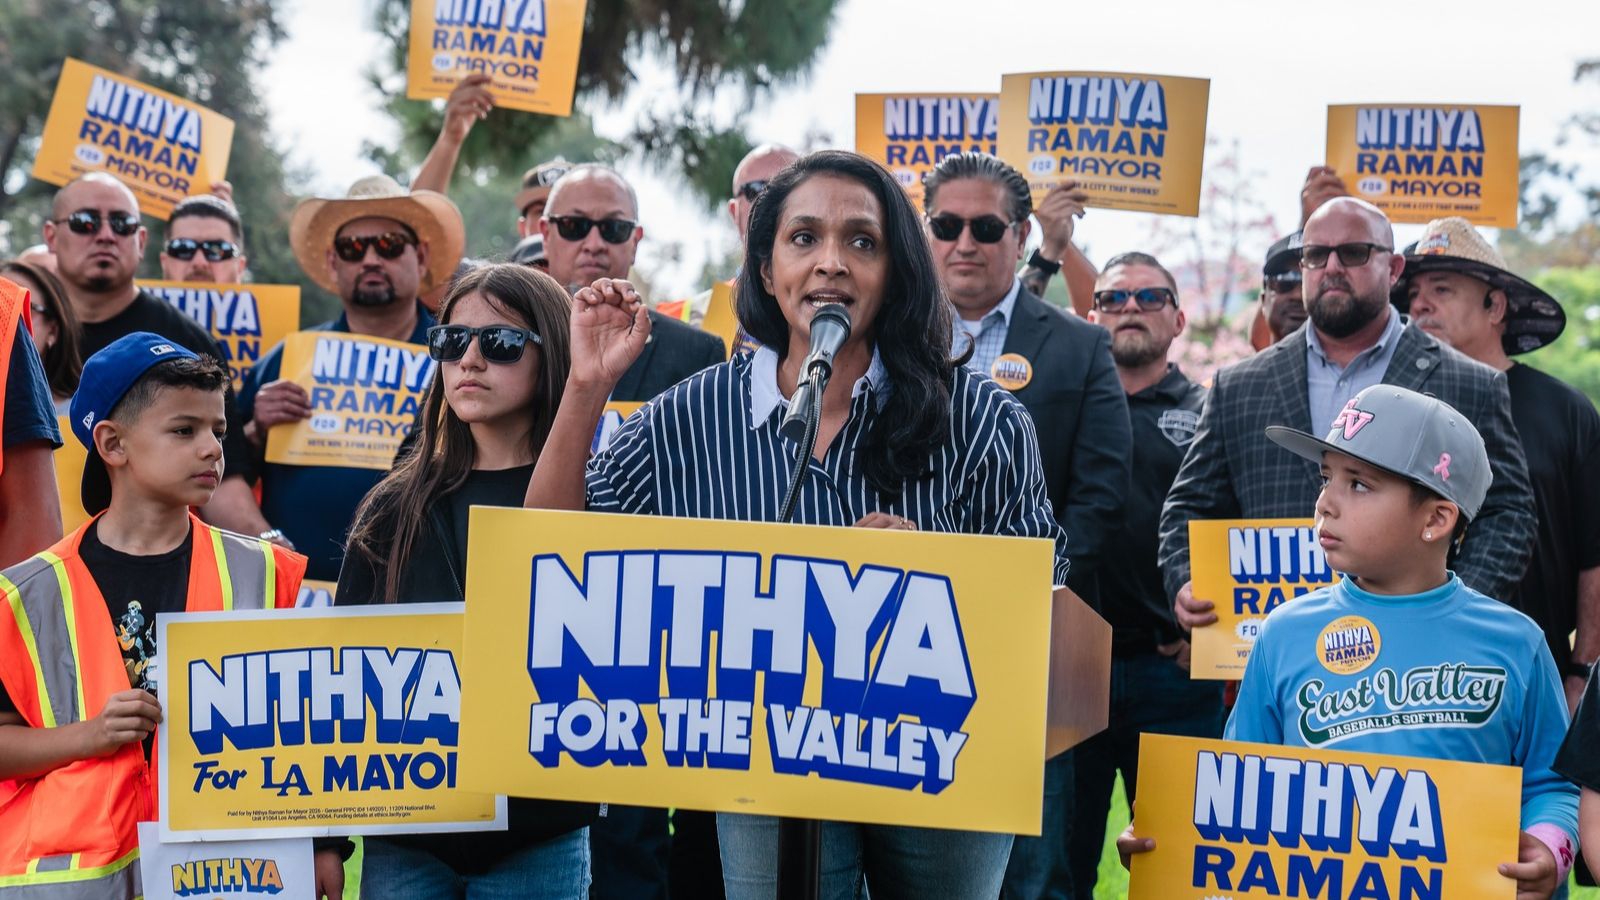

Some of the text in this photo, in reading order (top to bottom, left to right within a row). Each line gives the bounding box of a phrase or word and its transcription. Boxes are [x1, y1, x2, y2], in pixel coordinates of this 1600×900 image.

[432, 29, 543, 61] RAMAN
[455, 56, 539, 80] MAYOR
[86, 75, 201, 153] NITHYA
[1028, 77, 1168, 131] NITHYA
[79, 119, 198, 176] RAMAN
[1028, 128, 1165, 158] RAMAN
[1356, 109, 1485, 153] NITHYA
[106, 154, 190, 195] MAYOR
[1059, 156, 1162, 181] MAYOR
[1357, 153, 1483, 177] RAMAN
[1390, 179, 1481, 198] MAYOR
[311, 387, 419, 416] RAMA
[1229, 527, 1334, 583] NITH
[527, 549, 977, 730] NITHYA
[1242, 625, 1258, 636] FO
[1324, 625, 1374, 651] NITHYA
[1325, 644, 1375, 662] RAMAN
[188, 646, 461, 755] NITHYA
[1297, 662, 1506, 723] East Valley
[1328, 712, 1468, 738] BASEBALL & SOFTBALL
[528, 698, 969, 795] FOR THE VALLEY
[193, 760, 247, 793] For
[261, 756, 312, 796] LA
[1193, 750, 1448, 864] NITHYA
[171, 857, 284, 897] NITHYA
[1192, 844, 1443, 900] RAMAN
